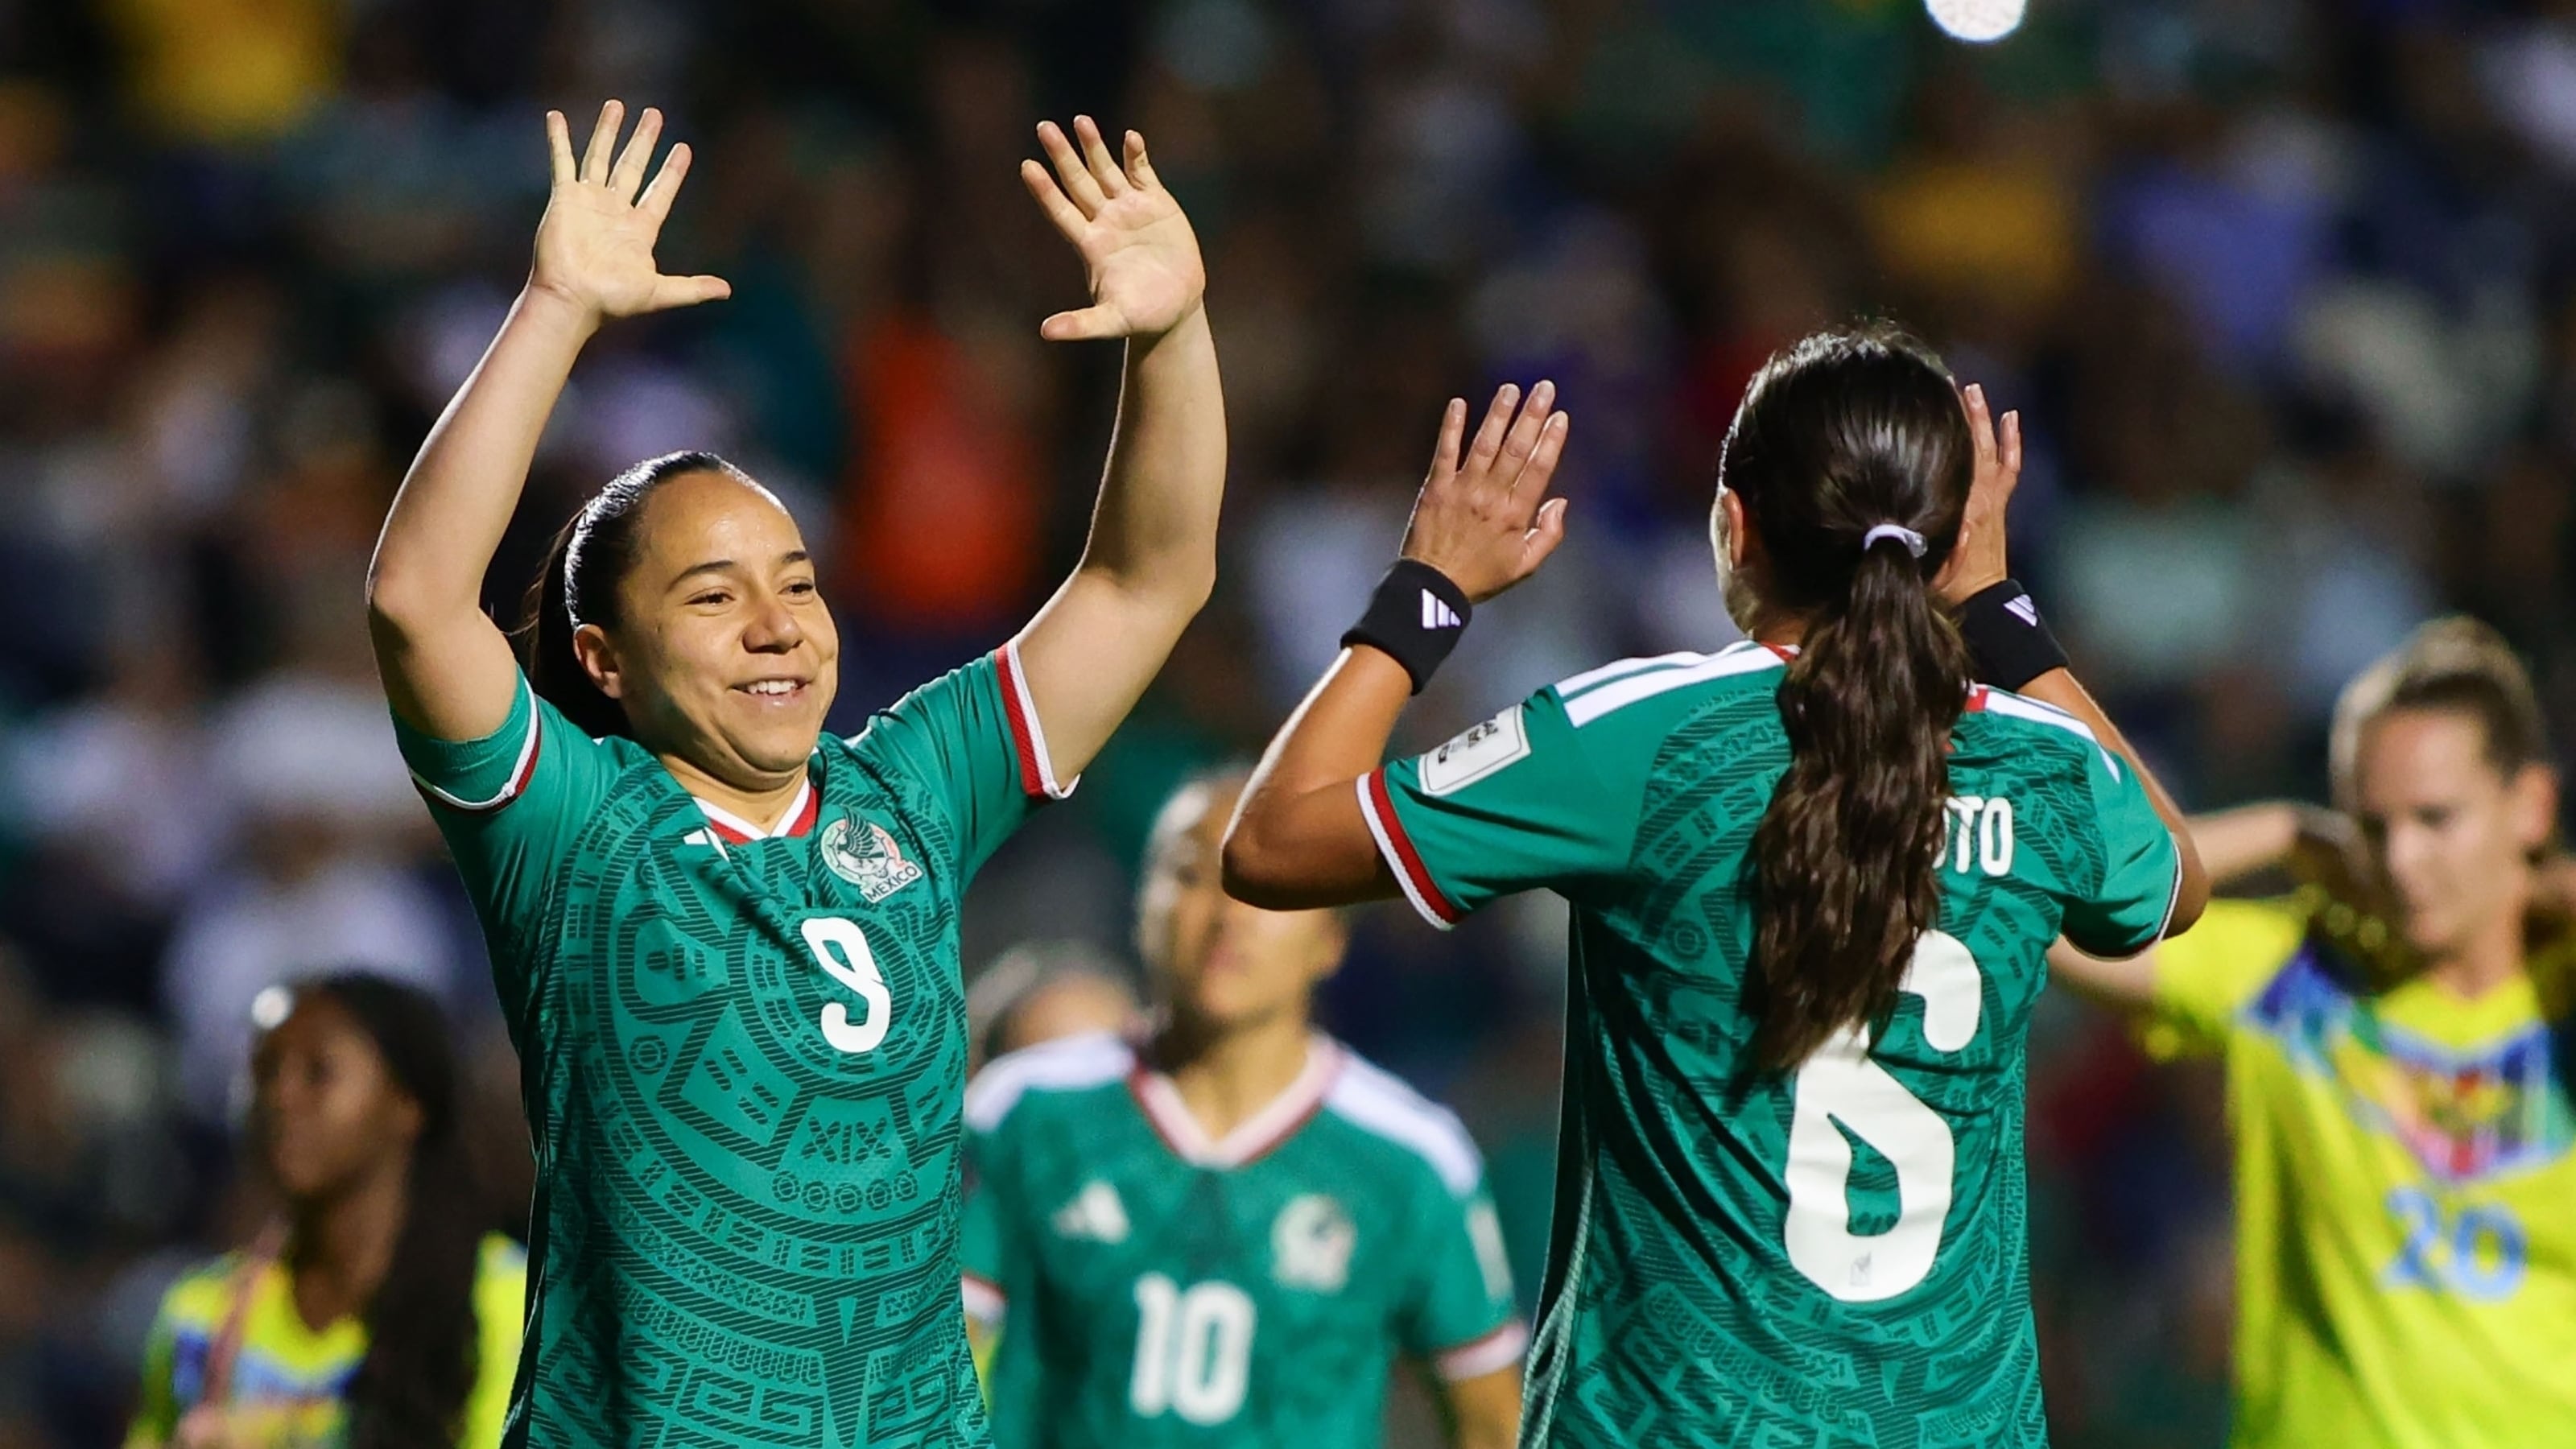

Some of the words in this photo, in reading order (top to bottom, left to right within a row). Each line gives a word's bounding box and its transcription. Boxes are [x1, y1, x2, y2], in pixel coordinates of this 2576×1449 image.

[1932, 795, 2014, 877] TO
[801, 917, 891, 1053] 9
[1785, 929, 1982, 1302] 6
[2376, 1186, 2528, 1302] 20
[1132, 1272, 1256, 1426] 10
